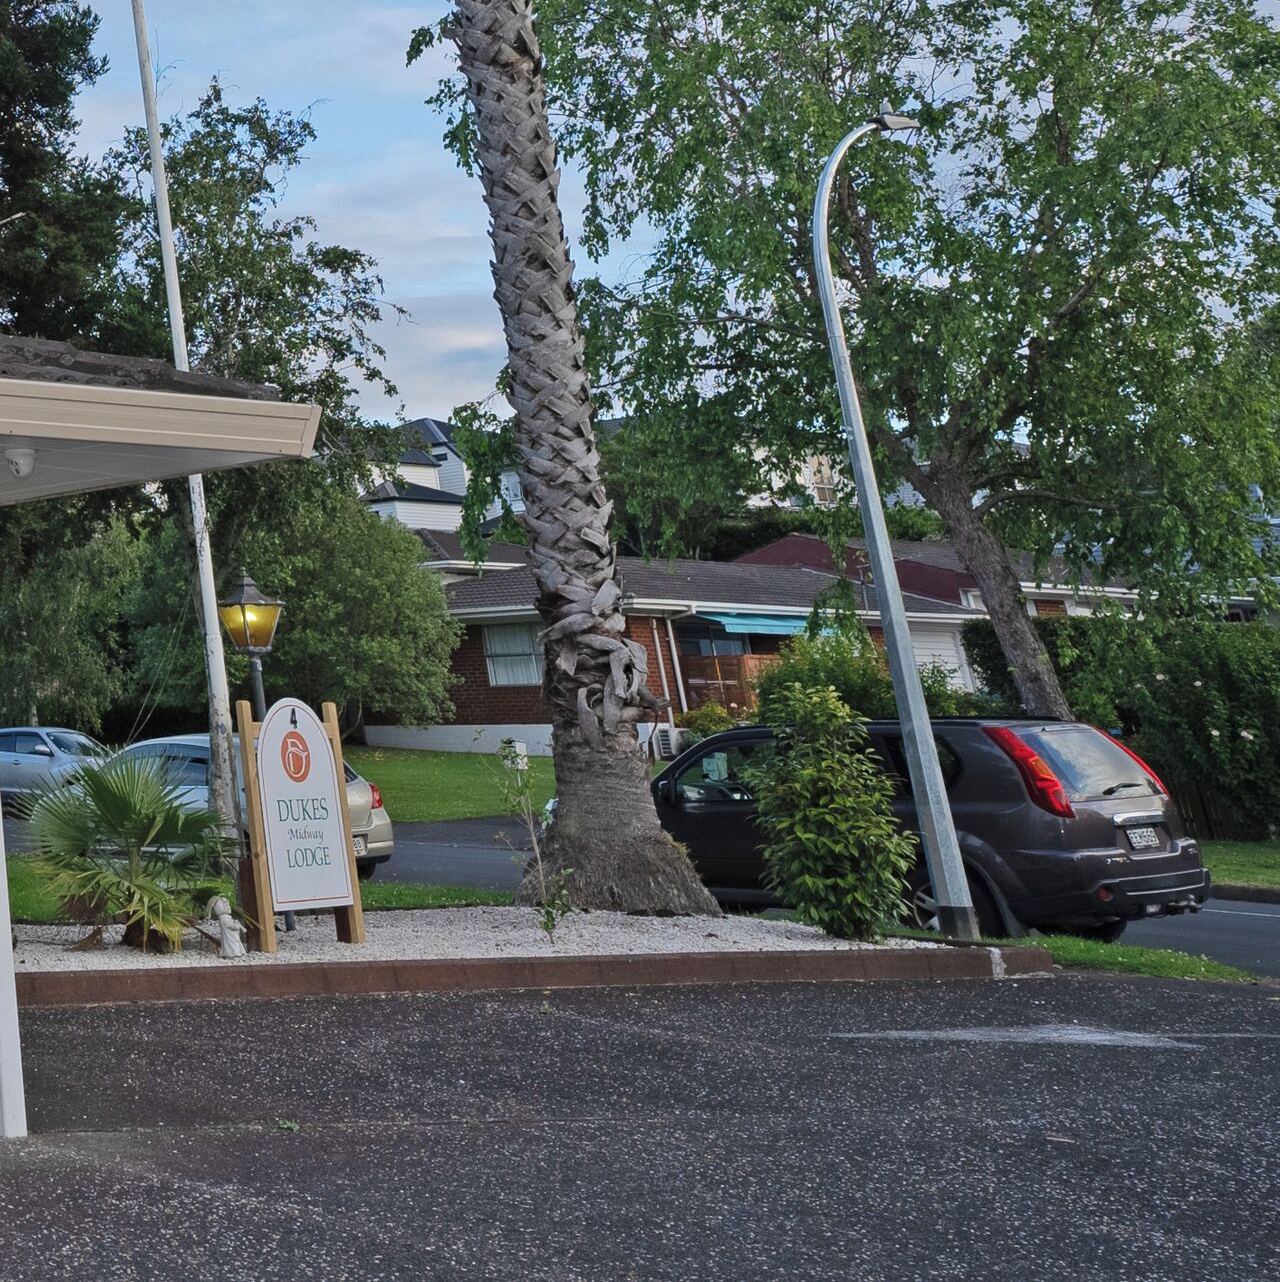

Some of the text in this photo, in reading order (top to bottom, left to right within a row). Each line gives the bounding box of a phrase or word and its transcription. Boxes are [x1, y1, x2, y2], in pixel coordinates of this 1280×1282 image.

[290, 707, 298, 729] 4
[276, 797, 329, 822] DUKES
[287, 825, 325, 844] Midway
[286, 847, 331, 868] LODGE
